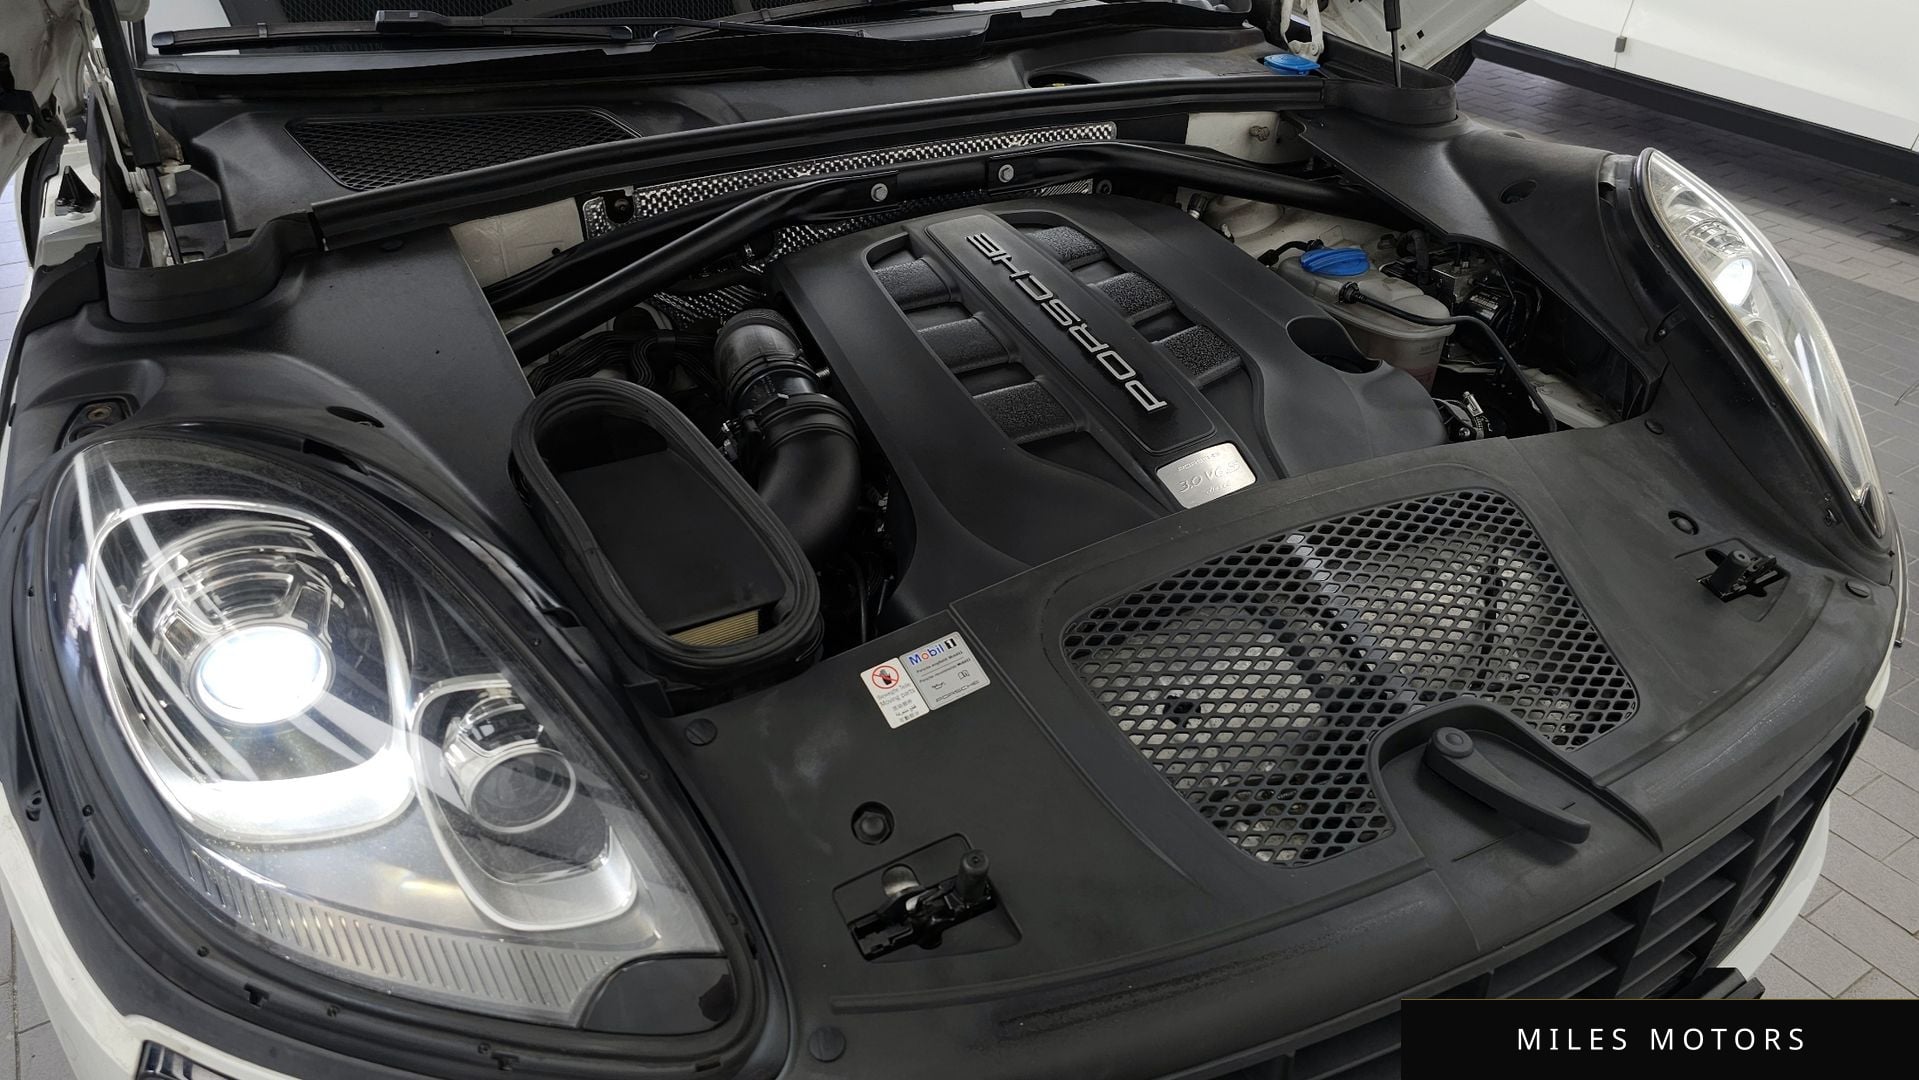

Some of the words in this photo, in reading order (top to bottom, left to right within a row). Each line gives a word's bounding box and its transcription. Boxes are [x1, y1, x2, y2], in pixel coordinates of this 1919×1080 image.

[965, 233, 1167, 411] PORSCHE
[908, 644, 945, 665] Mobil
[944, 638, 957, 649] 1
